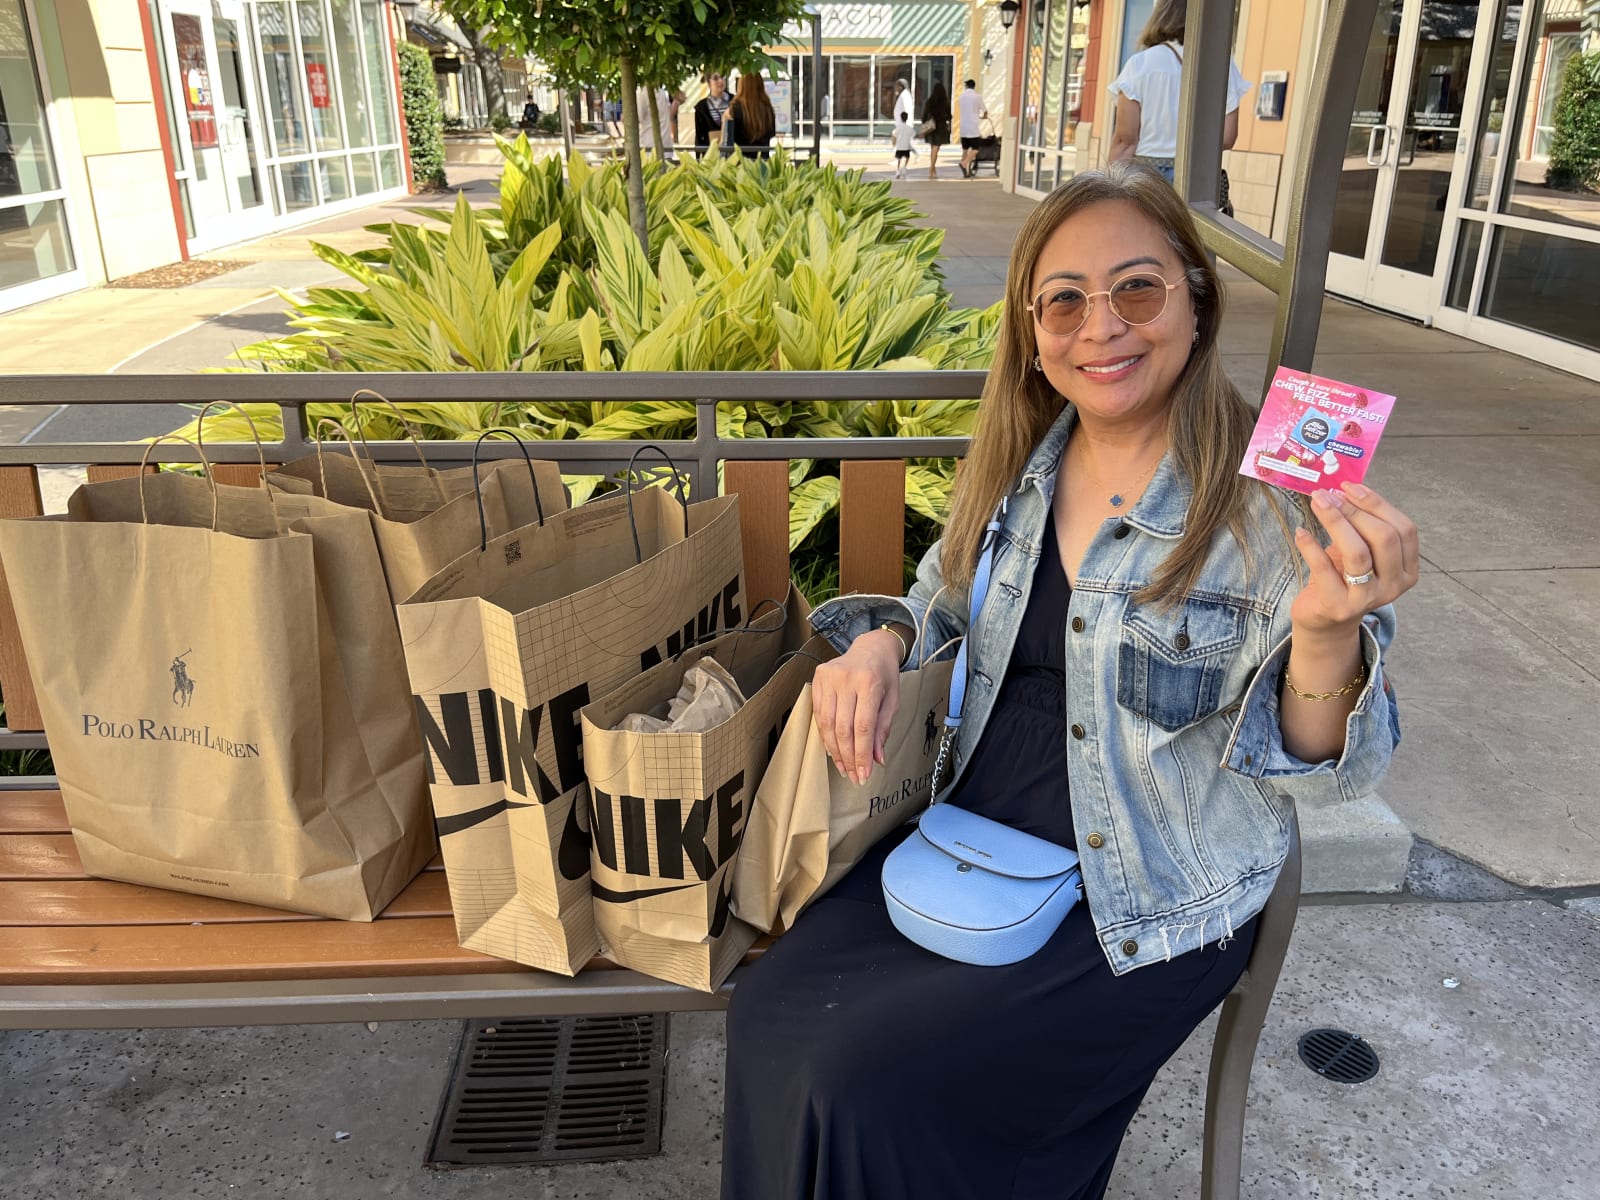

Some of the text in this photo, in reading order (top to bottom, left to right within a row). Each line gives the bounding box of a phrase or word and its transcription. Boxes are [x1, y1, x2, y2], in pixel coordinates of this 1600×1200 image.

[827, 8, 882, 25] ACH
[1288, 376, 1309, 386] Cough
[1331, 388, 1357, 398] throat?
[1292, 393, 1385, 424] FEEL BETTER FAST!
[82, 714, 260, 758] POLO RALPH LAUREN
[414, 682, 591, 805] NIKE
[868, 790, 899, 818] POLO
[587, 769, 745, 881] NIKE
